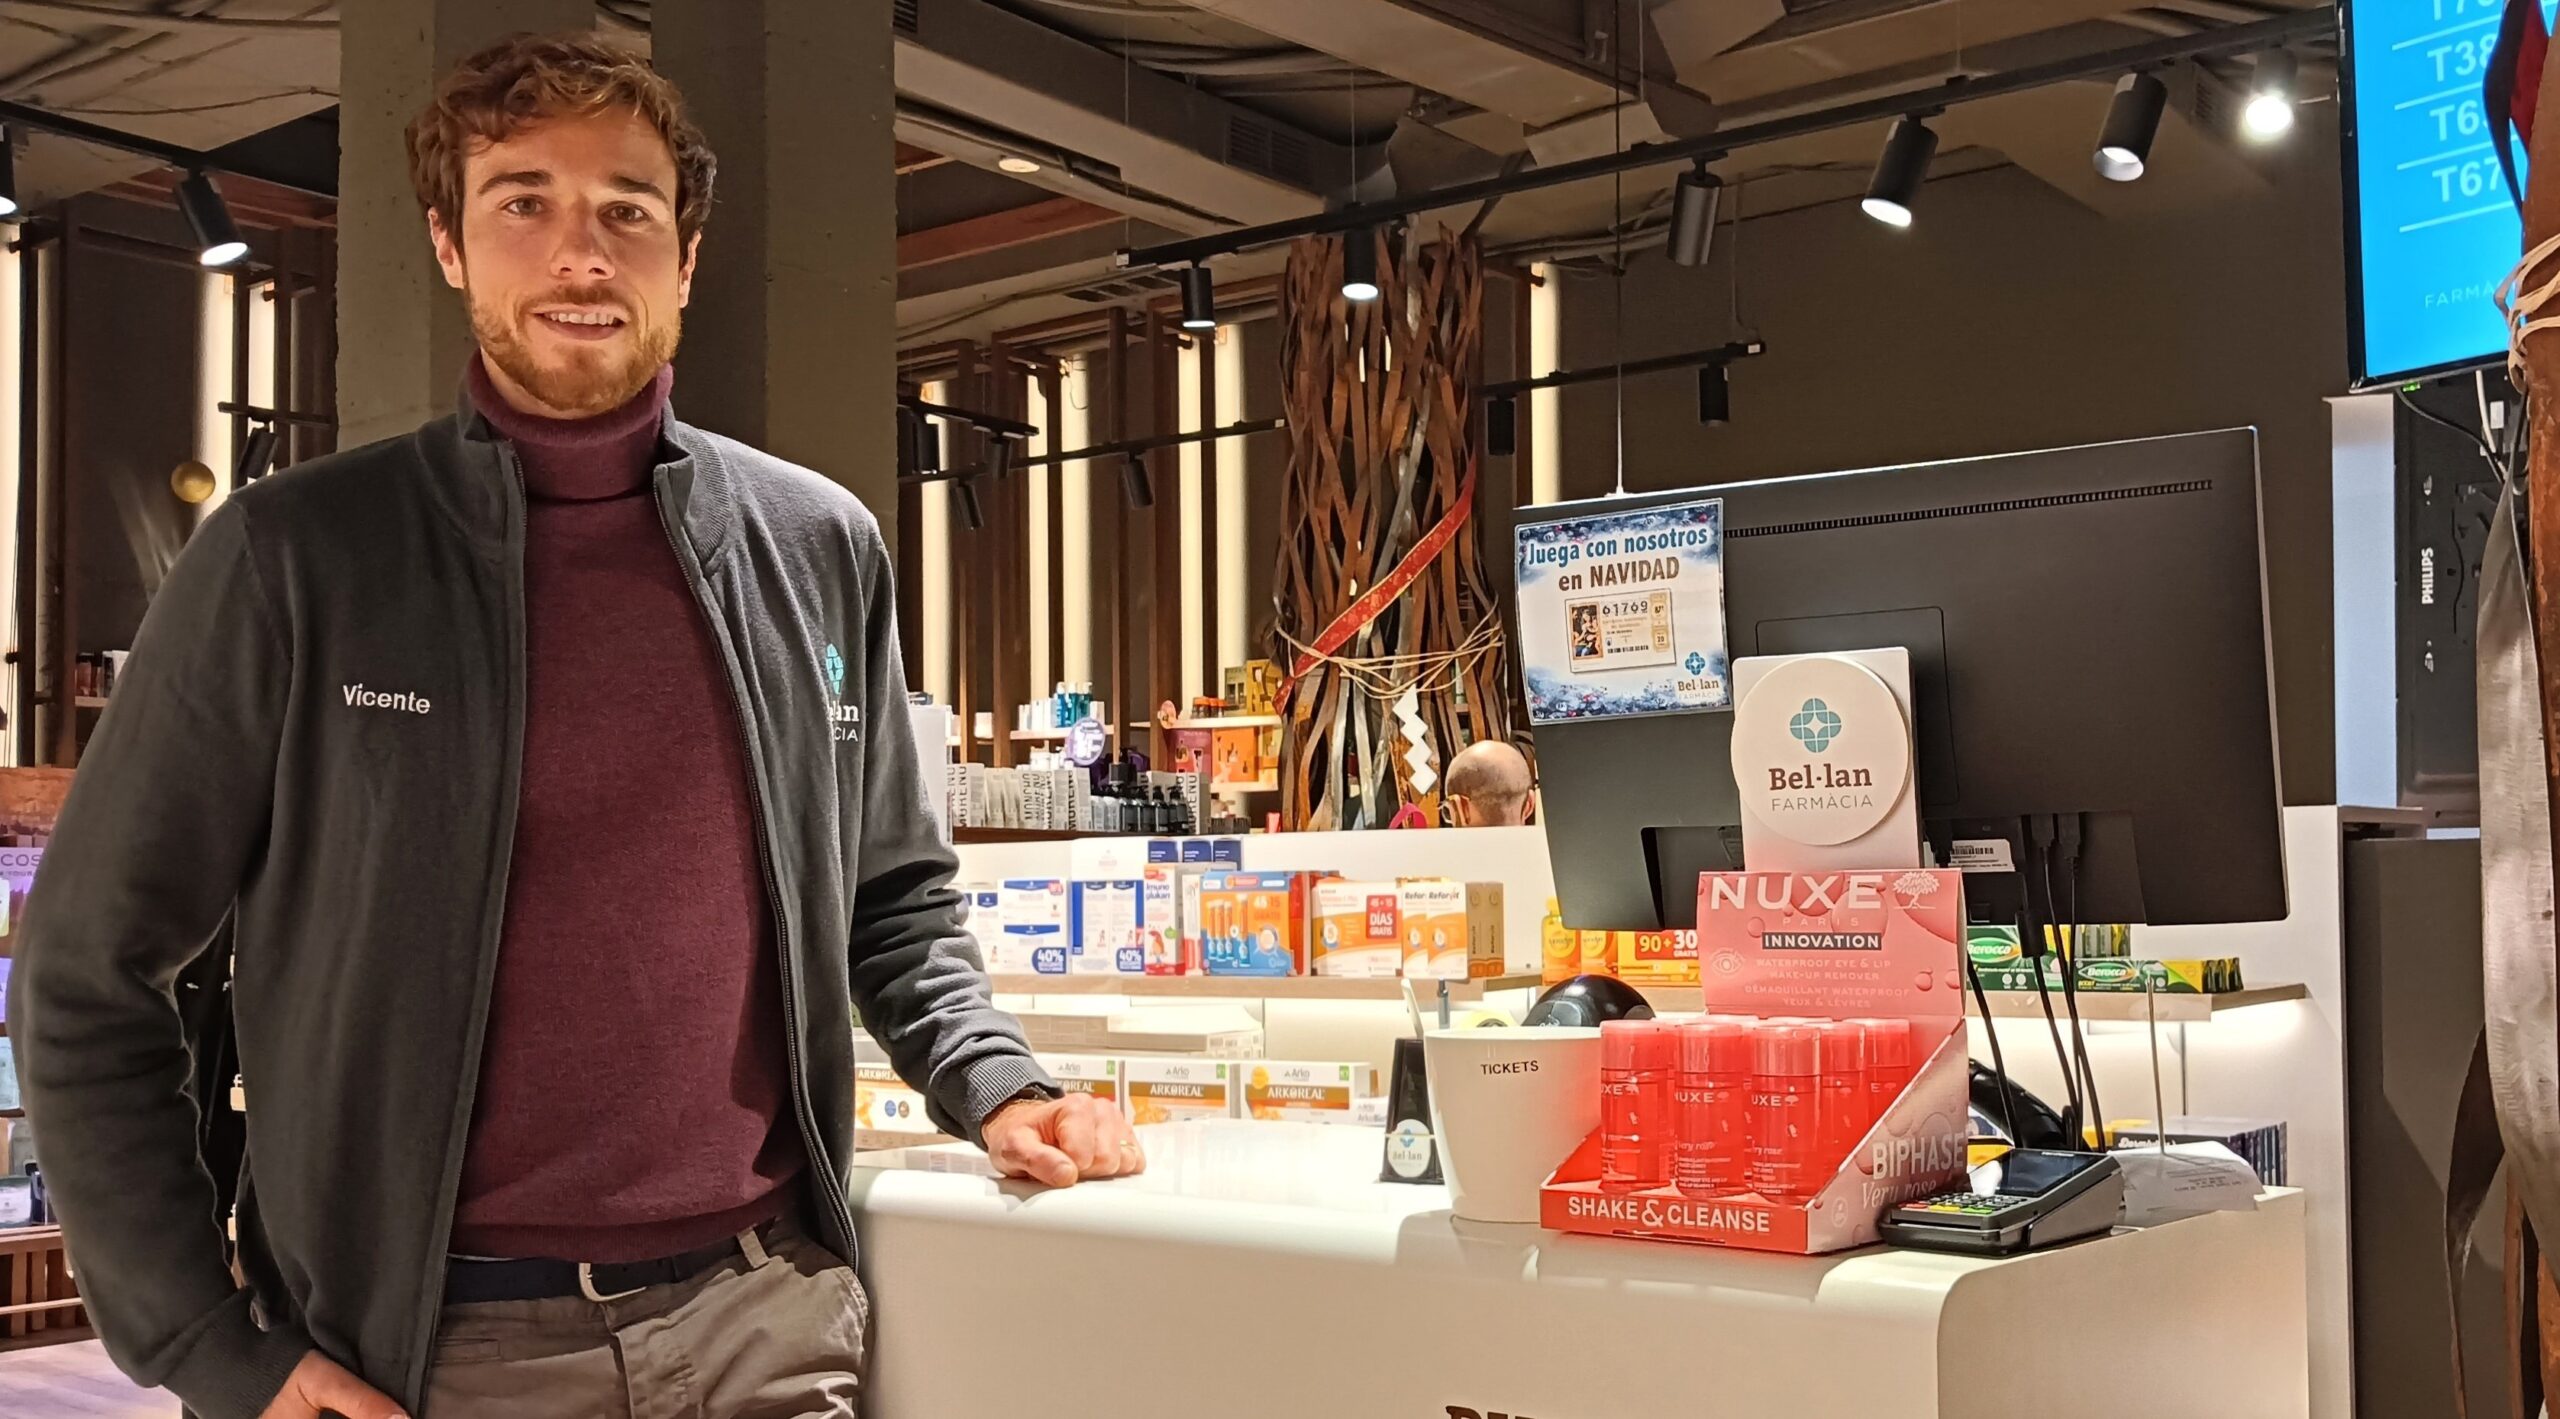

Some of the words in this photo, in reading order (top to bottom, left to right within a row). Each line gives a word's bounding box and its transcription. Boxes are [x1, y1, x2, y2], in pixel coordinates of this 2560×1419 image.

[2429, 99, 2490, 141] T6
[1529, 542, 1580, 568] Juega
[1586, 538, 1617, 558] con
[1624, 528, 1708, 553] nosotros
[1558, 572, 1582, 591] en
[1590, 556, 1680, 588] NAVIDAD
[2421, 546, 2434, 605] PHILIPS
[1602, 600, 1648, 616] 61769
[342, 683, 431, 714] Vicente
[1768, 763, 1873, 791] Bel·lan
[1771, 793, 1873, 812] FARMÀCIA
[1711, 874, 1883, 910] NUXE
[1370, 910, 1393, 926] DÍAS
[1782, 916, 1860, 927] PARIS
[1639, 935, 1662, 953] 90
[1673, 929, 1698, 950] 30
[1764, 934, 1880, 949] INNOVATION
[1037, 949, 1064, 962] 40%
[1119, 949, 1142, 962] 40%
[1756, 958, 1831, 968] WATERPROOF
[1873, 960, 1891, 969] LIP
[1770, 971, 1820, 980] MAKE-UP
[1825, 972, 1880, 981] REMOVER
[2087, 967, 2127, 977] Berocca
[1832, 987, 1909, 997] WATERPROOF
[1480, 1060, 1540, 1076] TICKETS
[1872, 1132, 1965, 1181] BIPHASE
[1568, 1196, 1639, 1220] SHAKE
[1641, 1199, 1664, 1228] &
[1666, 1204, 1771, 1233] CLEANSE
